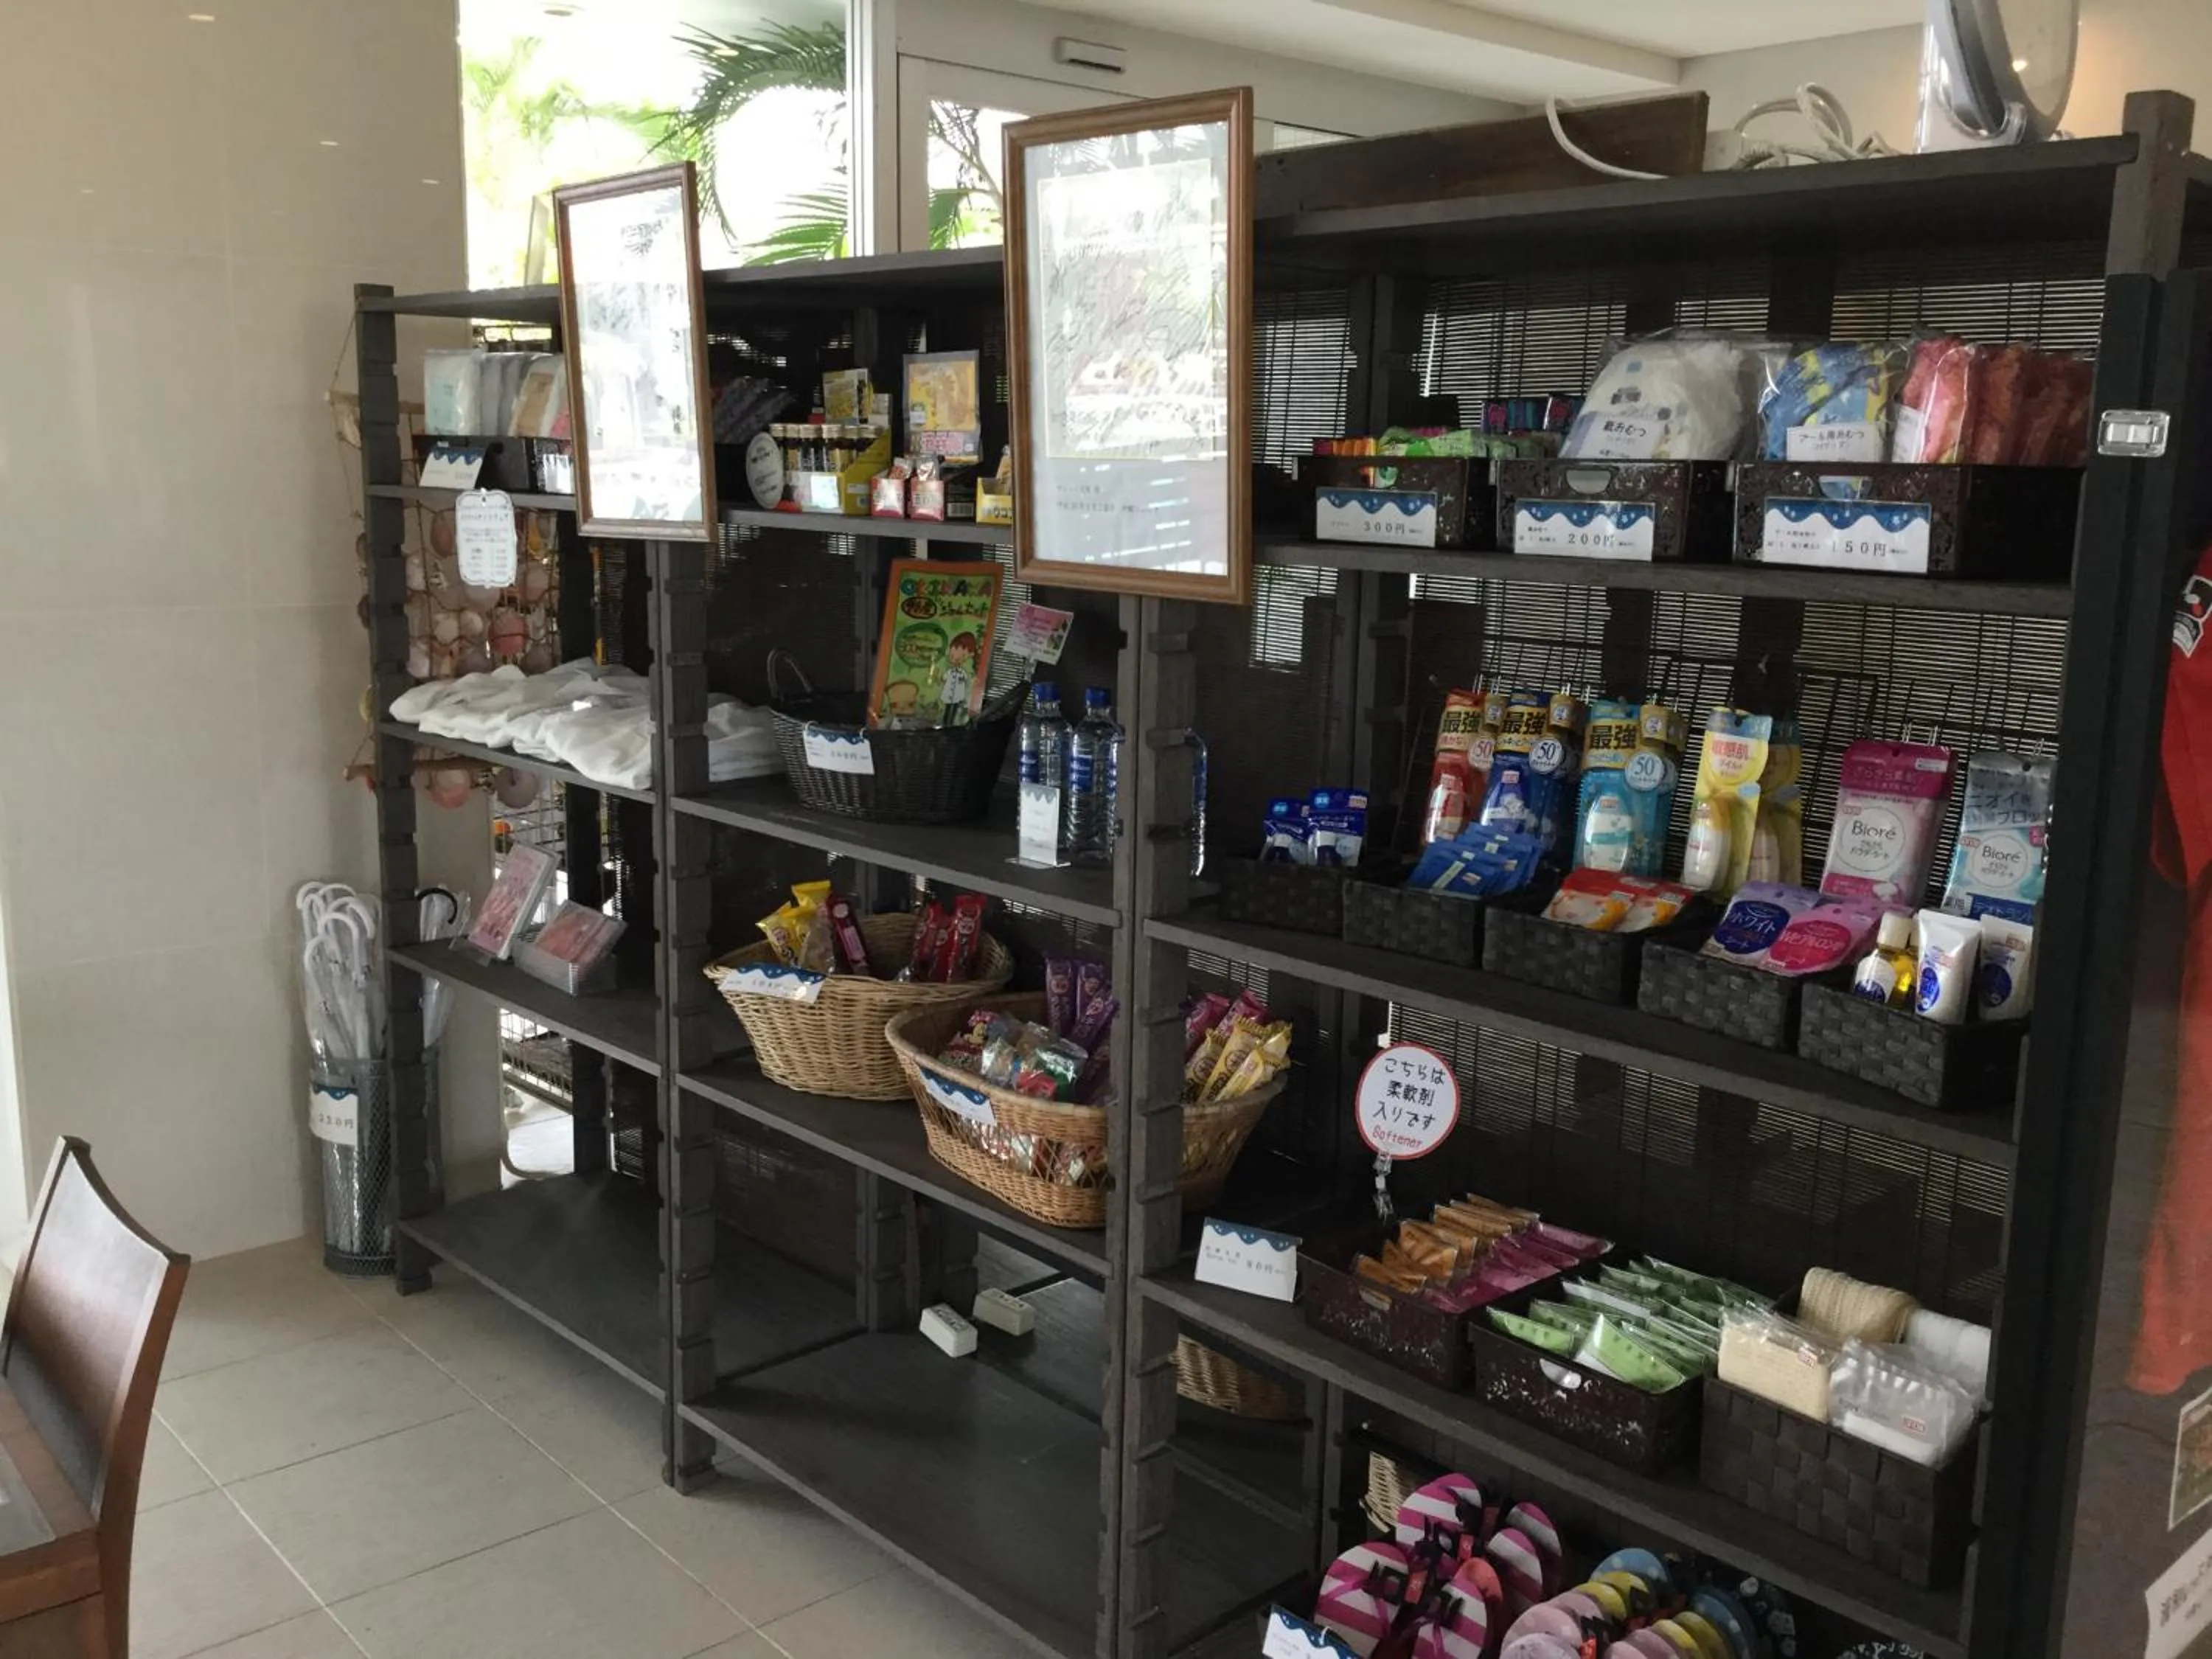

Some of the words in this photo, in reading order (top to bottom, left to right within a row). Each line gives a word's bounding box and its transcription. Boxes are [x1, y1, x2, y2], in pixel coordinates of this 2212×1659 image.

[1502, 711, 1546, 735] 最強
[1588, 724, 1638, 751] 最強
[1537, 742, 1557, 761] 50
[1633, 756, 1656, 776] 50
[1851, 819, 1896, 841] Bioré
[1982, 845, 2023, 863] Bioré
[1729, 911, 1776, 934] ホワイト
[1385, 1057, 1446, 1086] こちらは
[1386, 1079, 1436, 1107] 柔軟剤
[1372, 1100, 1436, 1131] 入りです
[1371, 1124, 1424, 1150] Softener
